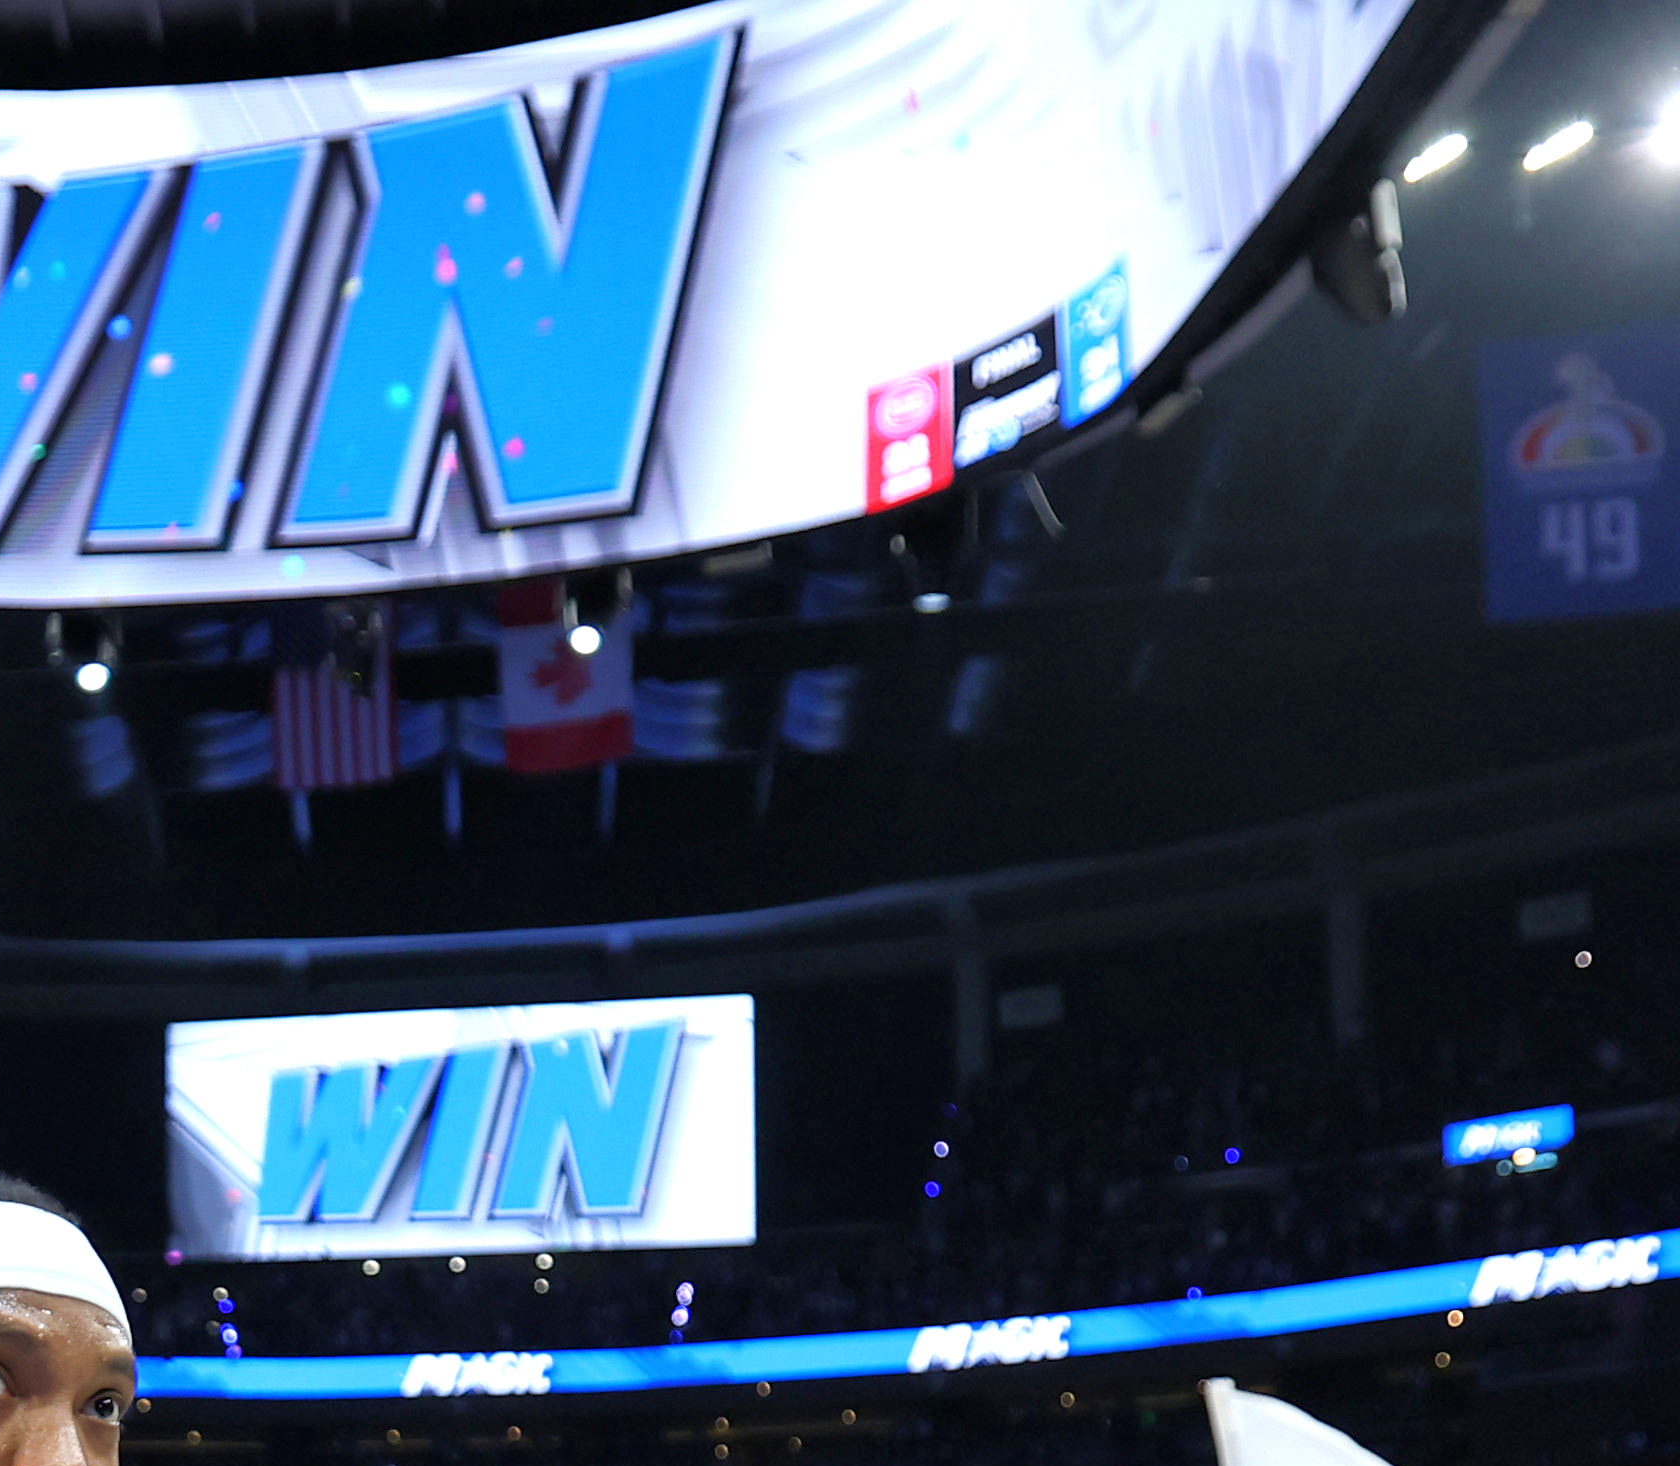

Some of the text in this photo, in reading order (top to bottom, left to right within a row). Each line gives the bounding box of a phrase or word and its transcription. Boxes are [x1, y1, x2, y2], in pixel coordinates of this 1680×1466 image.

[1542, 498, 1640, 580] 49
[258, 1017, 686, 1222] WIN
[1470, 1236, 1661, 1306] MAGIC
[907, 1315, 1071, 1373] MAGIC
